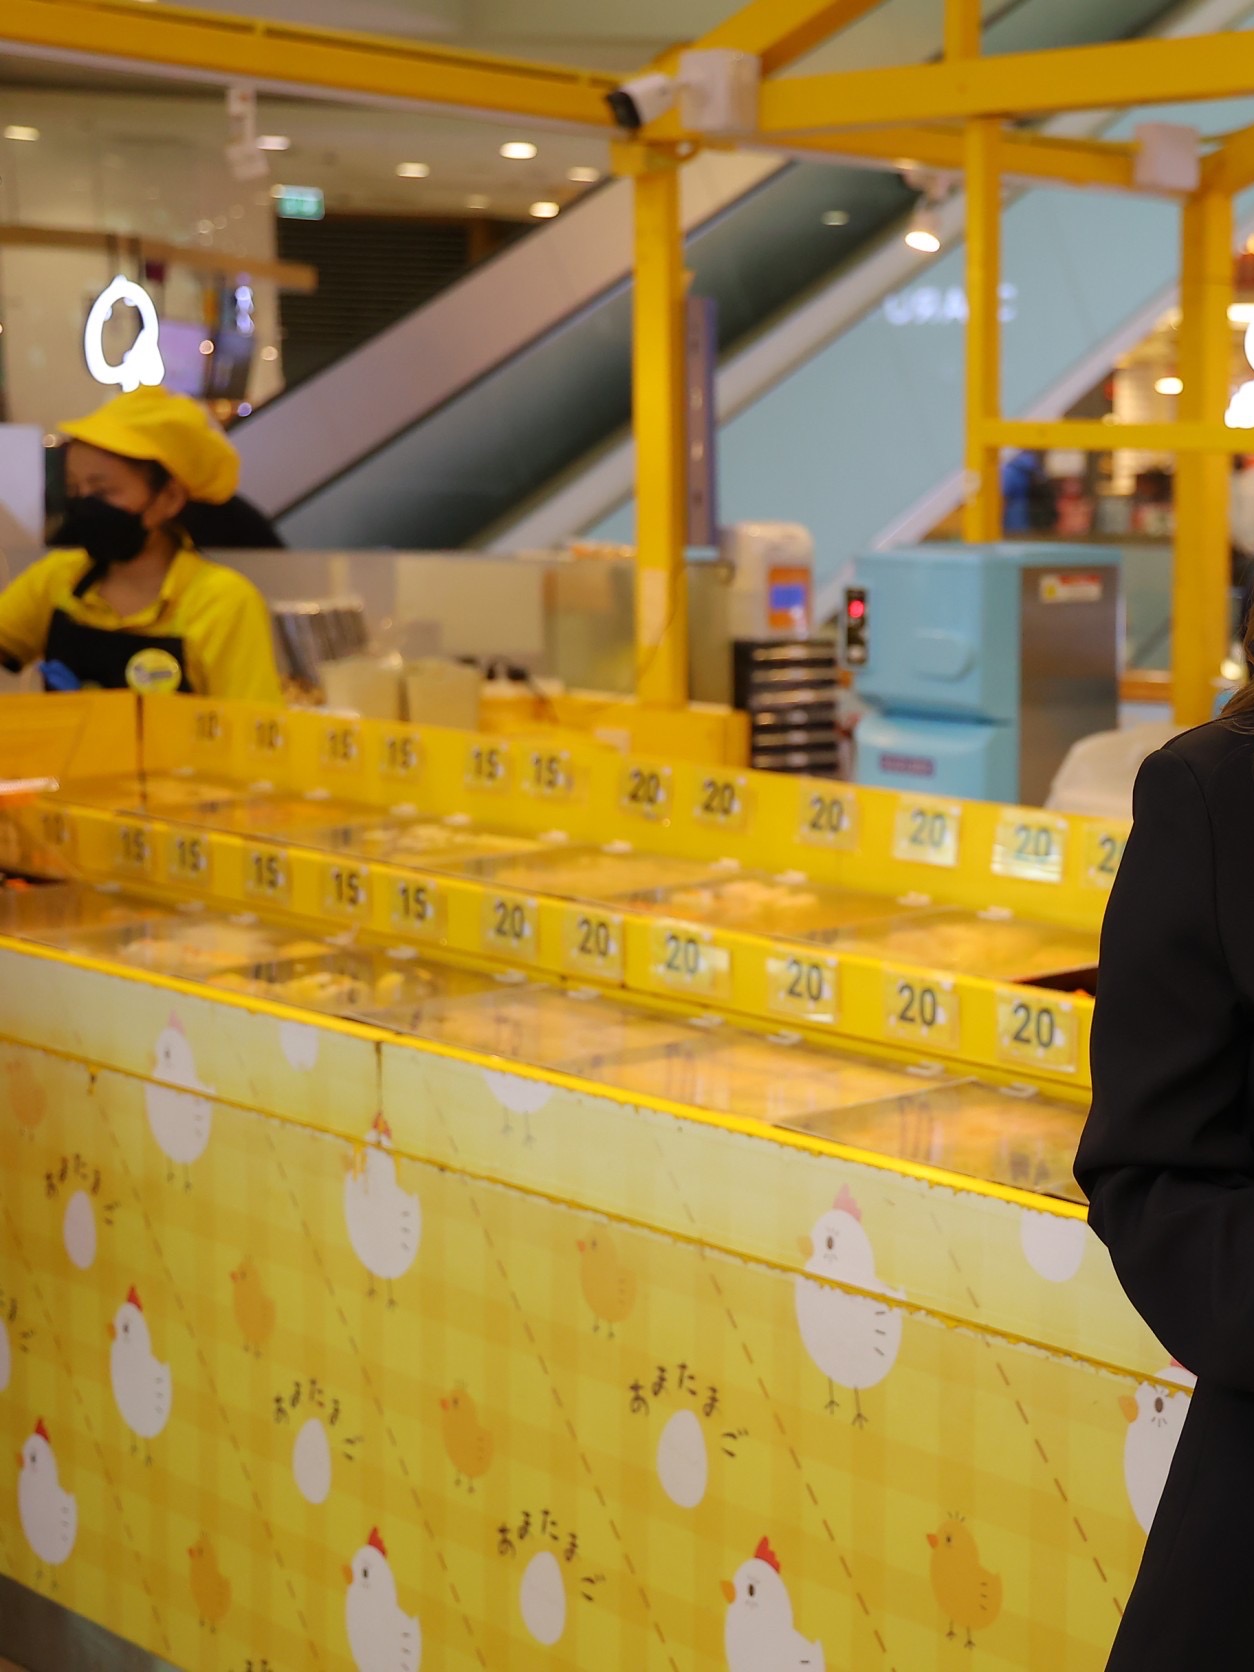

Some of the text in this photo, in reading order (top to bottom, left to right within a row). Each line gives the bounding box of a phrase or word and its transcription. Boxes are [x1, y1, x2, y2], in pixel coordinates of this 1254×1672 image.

[387, 737, 414, 771] 15
[473, 748, 500, 782] 15
[534, 756, 562, 789] 15
[628, 768, 662, 806] 20
[703, 779, 737, 816] 20
[809, 796, 844, 833] 20
[910, 809, 948, 850] 20
[177, 838, 203, 873] 15
[1015, 824, 1053, 863] 20
[254, 854, 282, 890] 15
[334, 871, 361, 907] 15
[399, 886, 429, 922] 15
[494, 901, 527, 939] 20
[578, 918, 611, 958] 20
[666, 934, 701, 975] 20
[786, 958, 825, 1003] 20
[897, 983, 938, 1027] 20
[1012, 1003, 1055, 1049] 20
